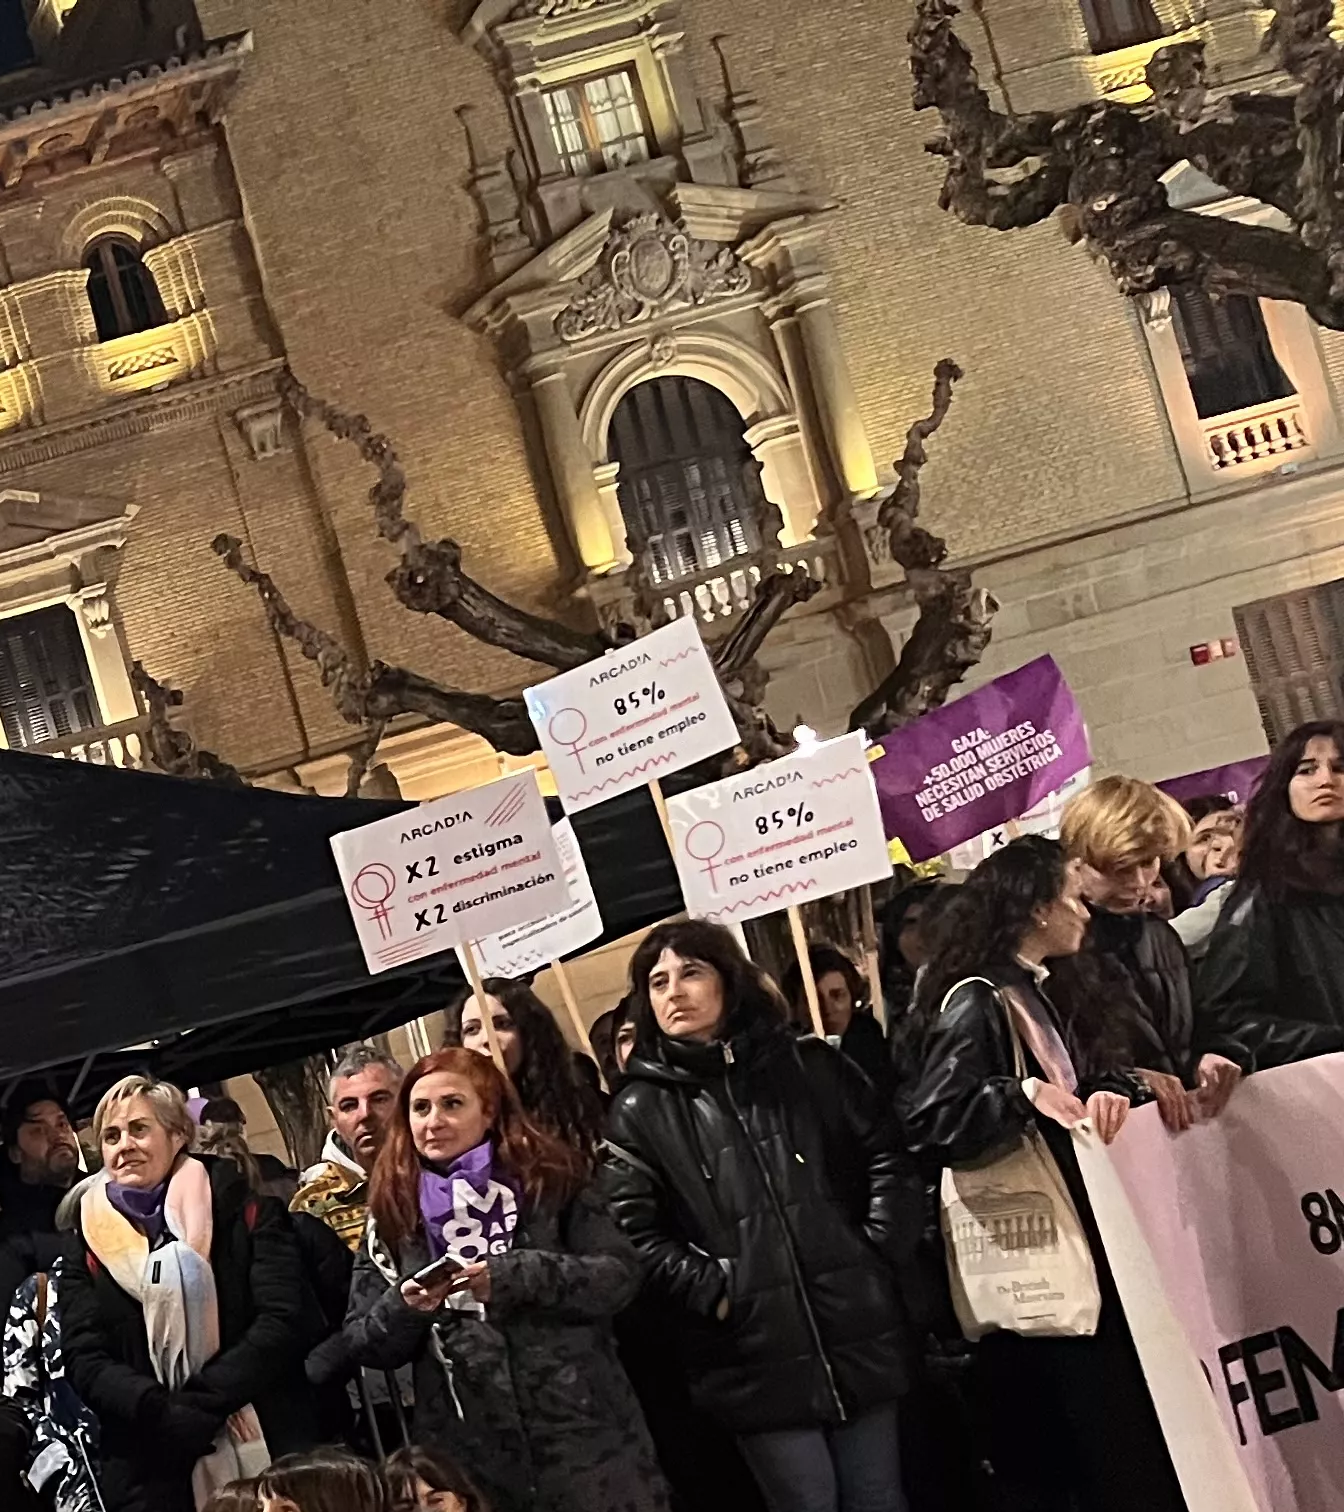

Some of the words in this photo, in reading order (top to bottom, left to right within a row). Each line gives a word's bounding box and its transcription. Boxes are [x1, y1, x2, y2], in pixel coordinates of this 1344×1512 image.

[614, 681, 665, 715] 85%
[596, 753, 614, 766] no
[617, 735, 654, 756] tiene
[658, 712, 706, 739] empleo
[923, 751, 978, 786] +50.000
[975, 720, 1036, 761] MUJERES
[951, 727, 992, 754] GAZA:
[914, 763, 988, 808] NECESITAN
[986, 729, 1056, 773] SERVICIOS
[755, 801, 814, 835] 85%
[921, 805, 943, 823] DE
[942, 783, 985, 813] SALUD
[400, 811, 473, 844] ARCADIA
[453, 833, 523, 865] estigma
[729, 873, 749, 887] no
[753, 858, 794, 878] tiene
[799, 839, 858, 865] empleo
[430, 865, 499, 896] enfermedad
[501, 851, 541, 871] mental
[452, 872, 555, 914] discriminación
